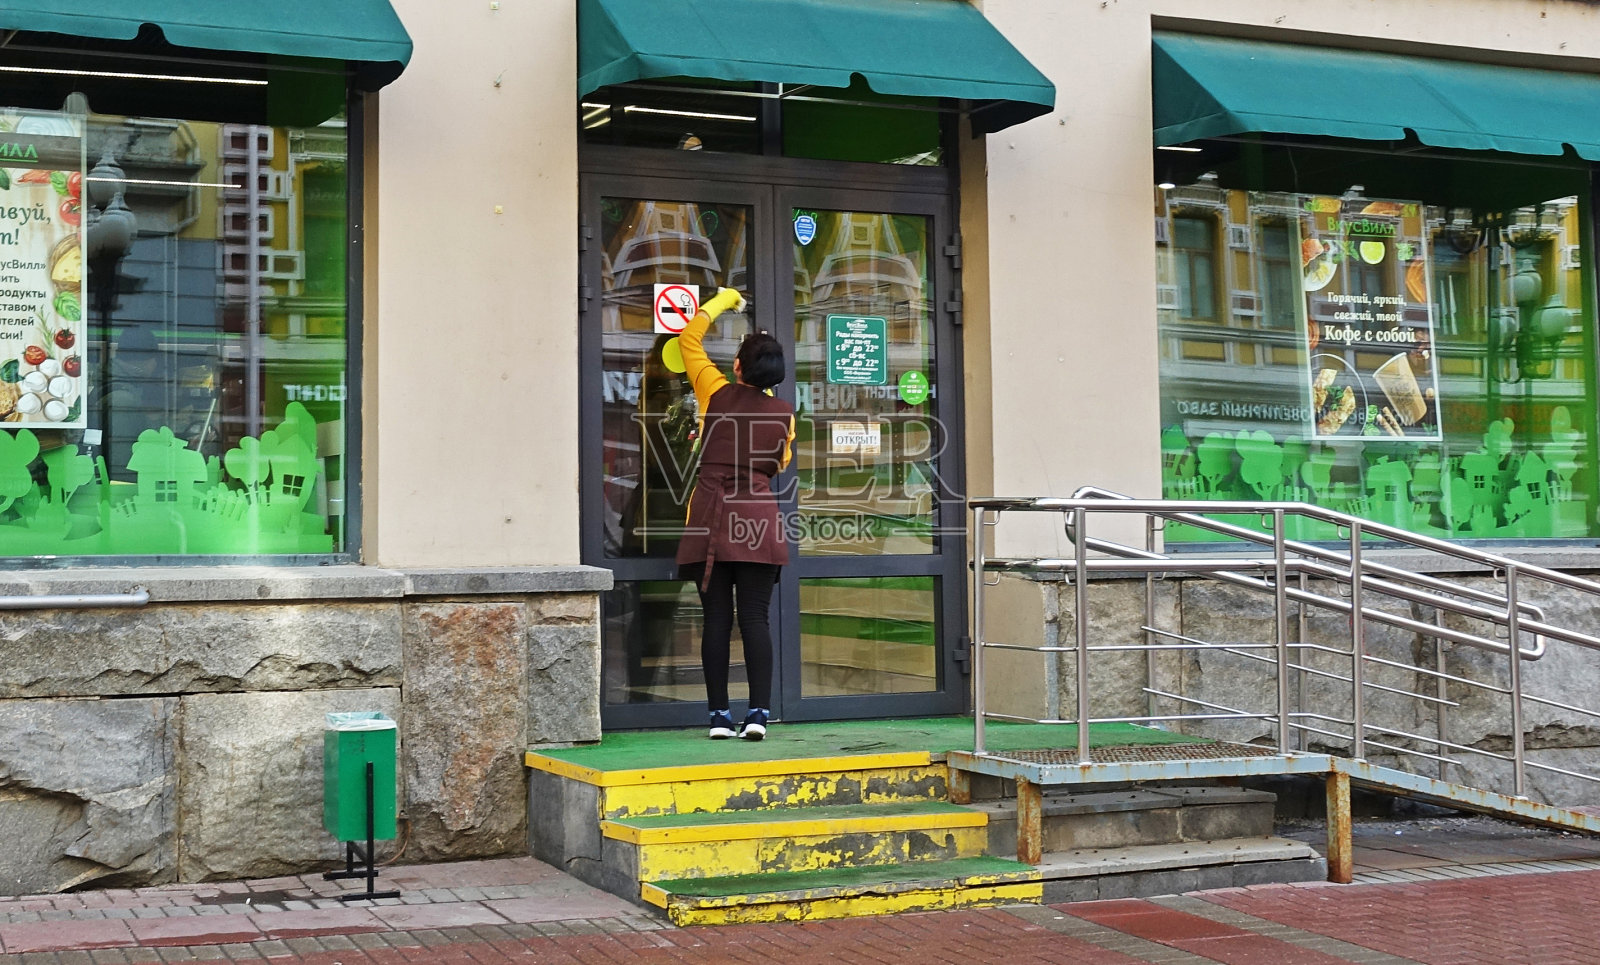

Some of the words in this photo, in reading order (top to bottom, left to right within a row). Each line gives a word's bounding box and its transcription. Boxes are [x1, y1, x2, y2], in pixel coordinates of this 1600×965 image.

[0, 275, 20, 283] ить
[1327, 292, 1372, 305] Горячий,
[1373, 295, 1407, 307] яркий,
[0, 316, 34, 326] телей
[1334, 310, 1374, 323] свежий,
[1376, 312, 1403, 322] твой
[1324, 325, 1362, 346] Кофе
[1364, 331, 1373, 340] с
[1376, 327, 1416, 343] собой
